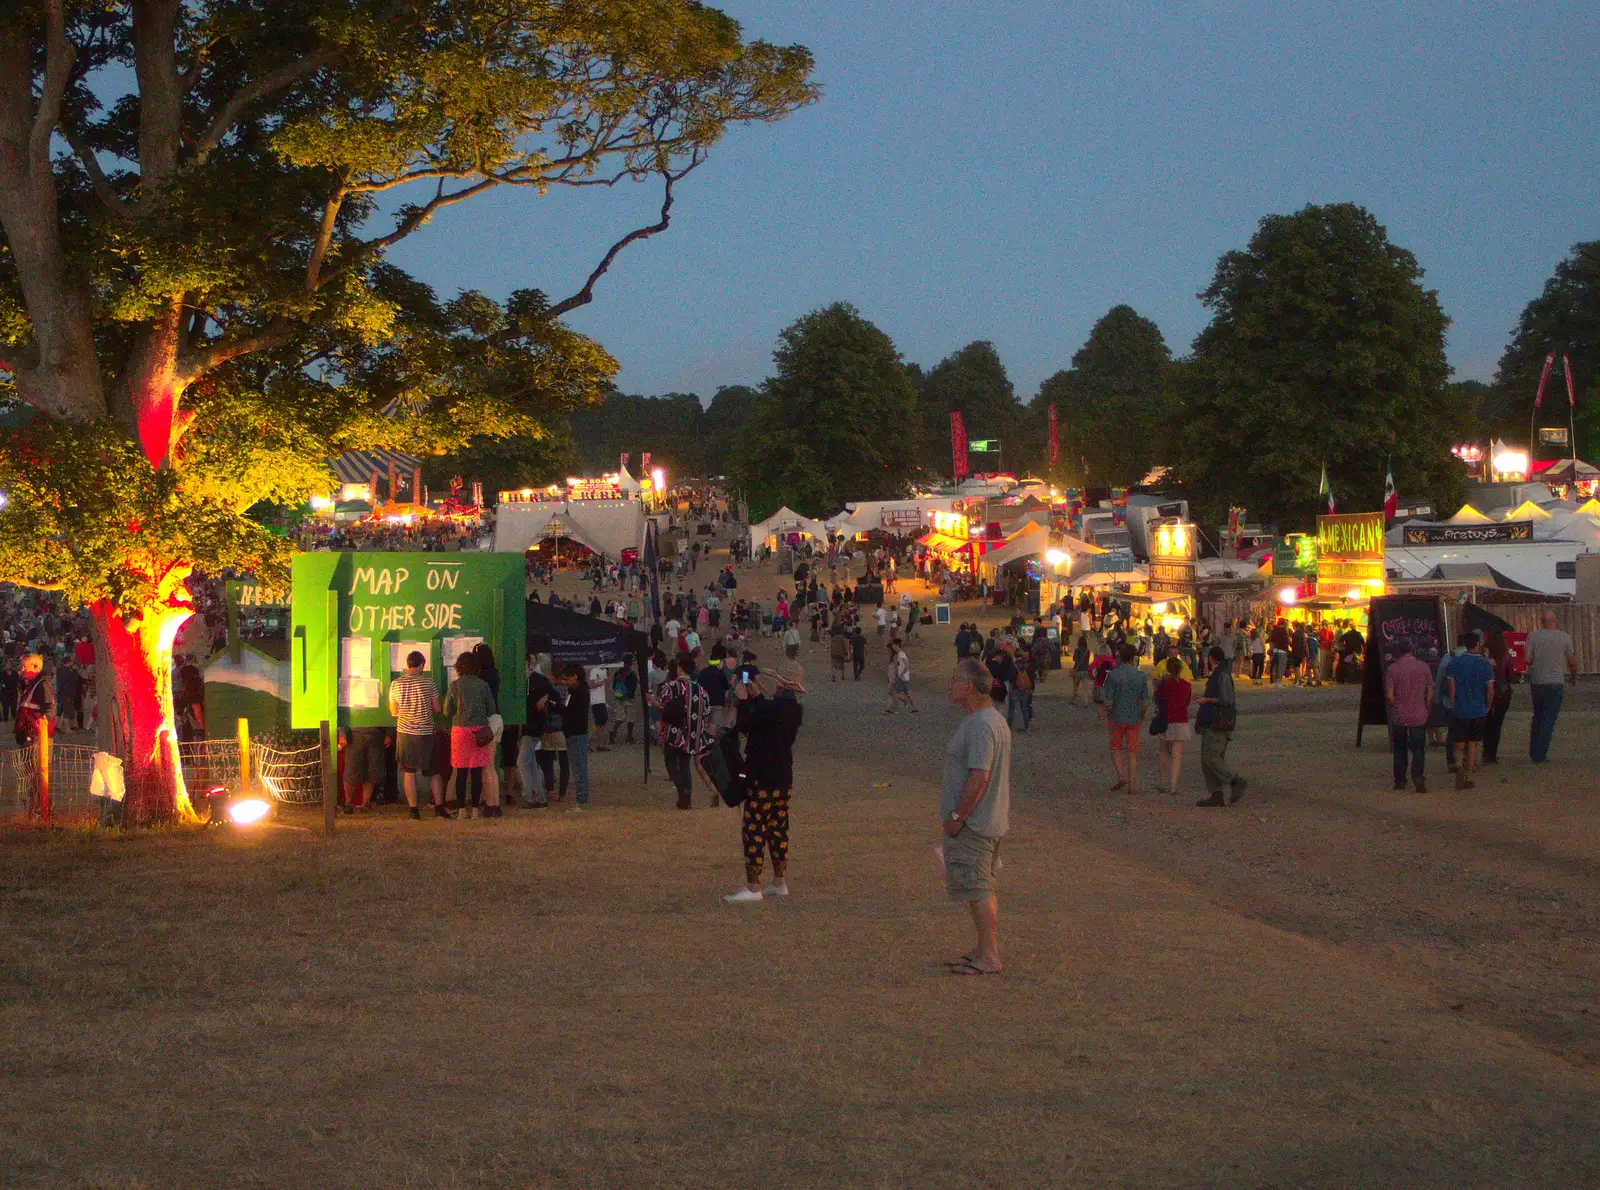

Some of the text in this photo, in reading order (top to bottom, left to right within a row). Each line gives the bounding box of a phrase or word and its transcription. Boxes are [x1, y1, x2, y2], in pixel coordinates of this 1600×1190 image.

[1326, 519, 1375, 553] MEXICAN
[348, 567, 460, 595] MAP ON
[350, 603, 462, 632] OTHER SIDE
